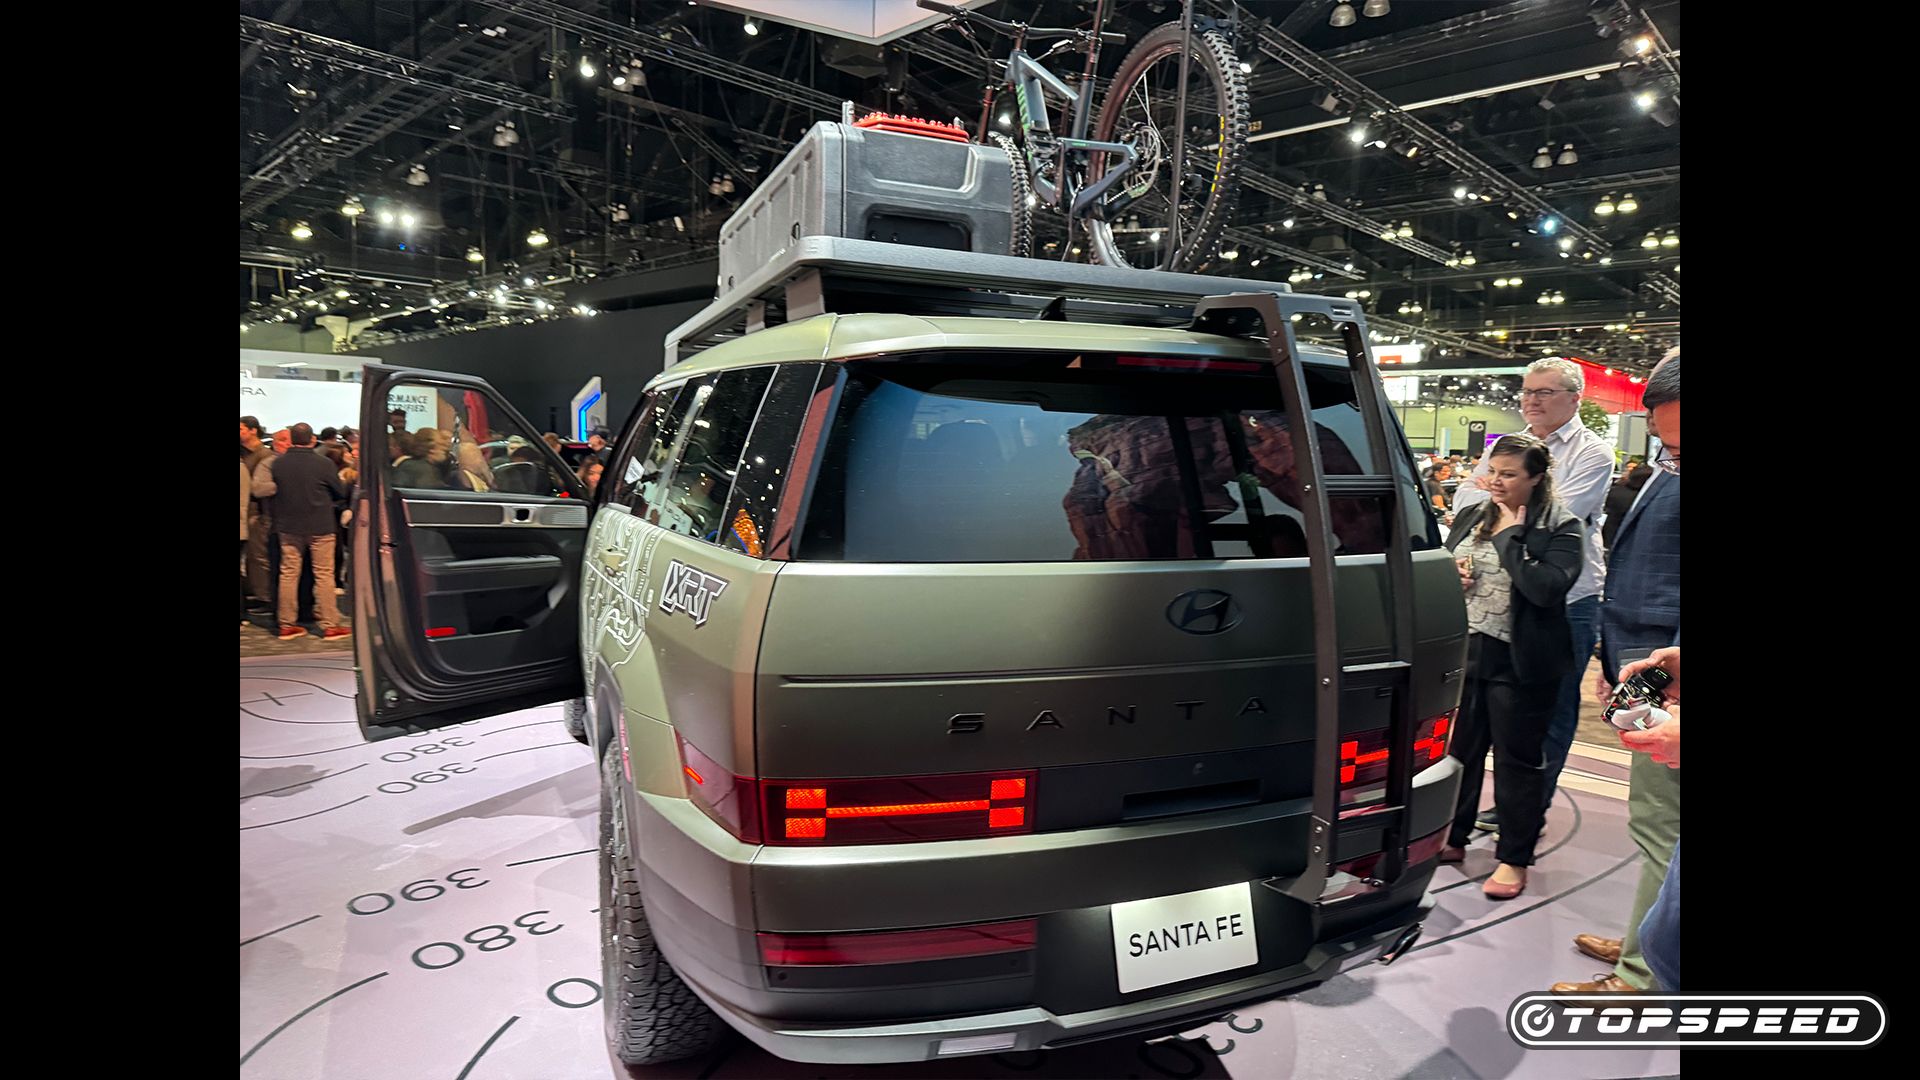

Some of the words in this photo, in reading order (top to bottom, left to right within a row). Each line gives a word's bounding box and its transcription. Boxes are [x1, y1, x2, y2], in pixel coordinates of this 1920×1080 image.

[659, 558, 729, 629] XRT
[947, 696, 1268, 734] SANTA
[380, 736, 476, 763] 380
[376, 762, 478, 794] 390
[346, 868, 491, 916] 390
[411, 910, 564, 970] 380
[1129, 920, 1212, 957] SANTA
[1216, 913, 1244, 940] FE
